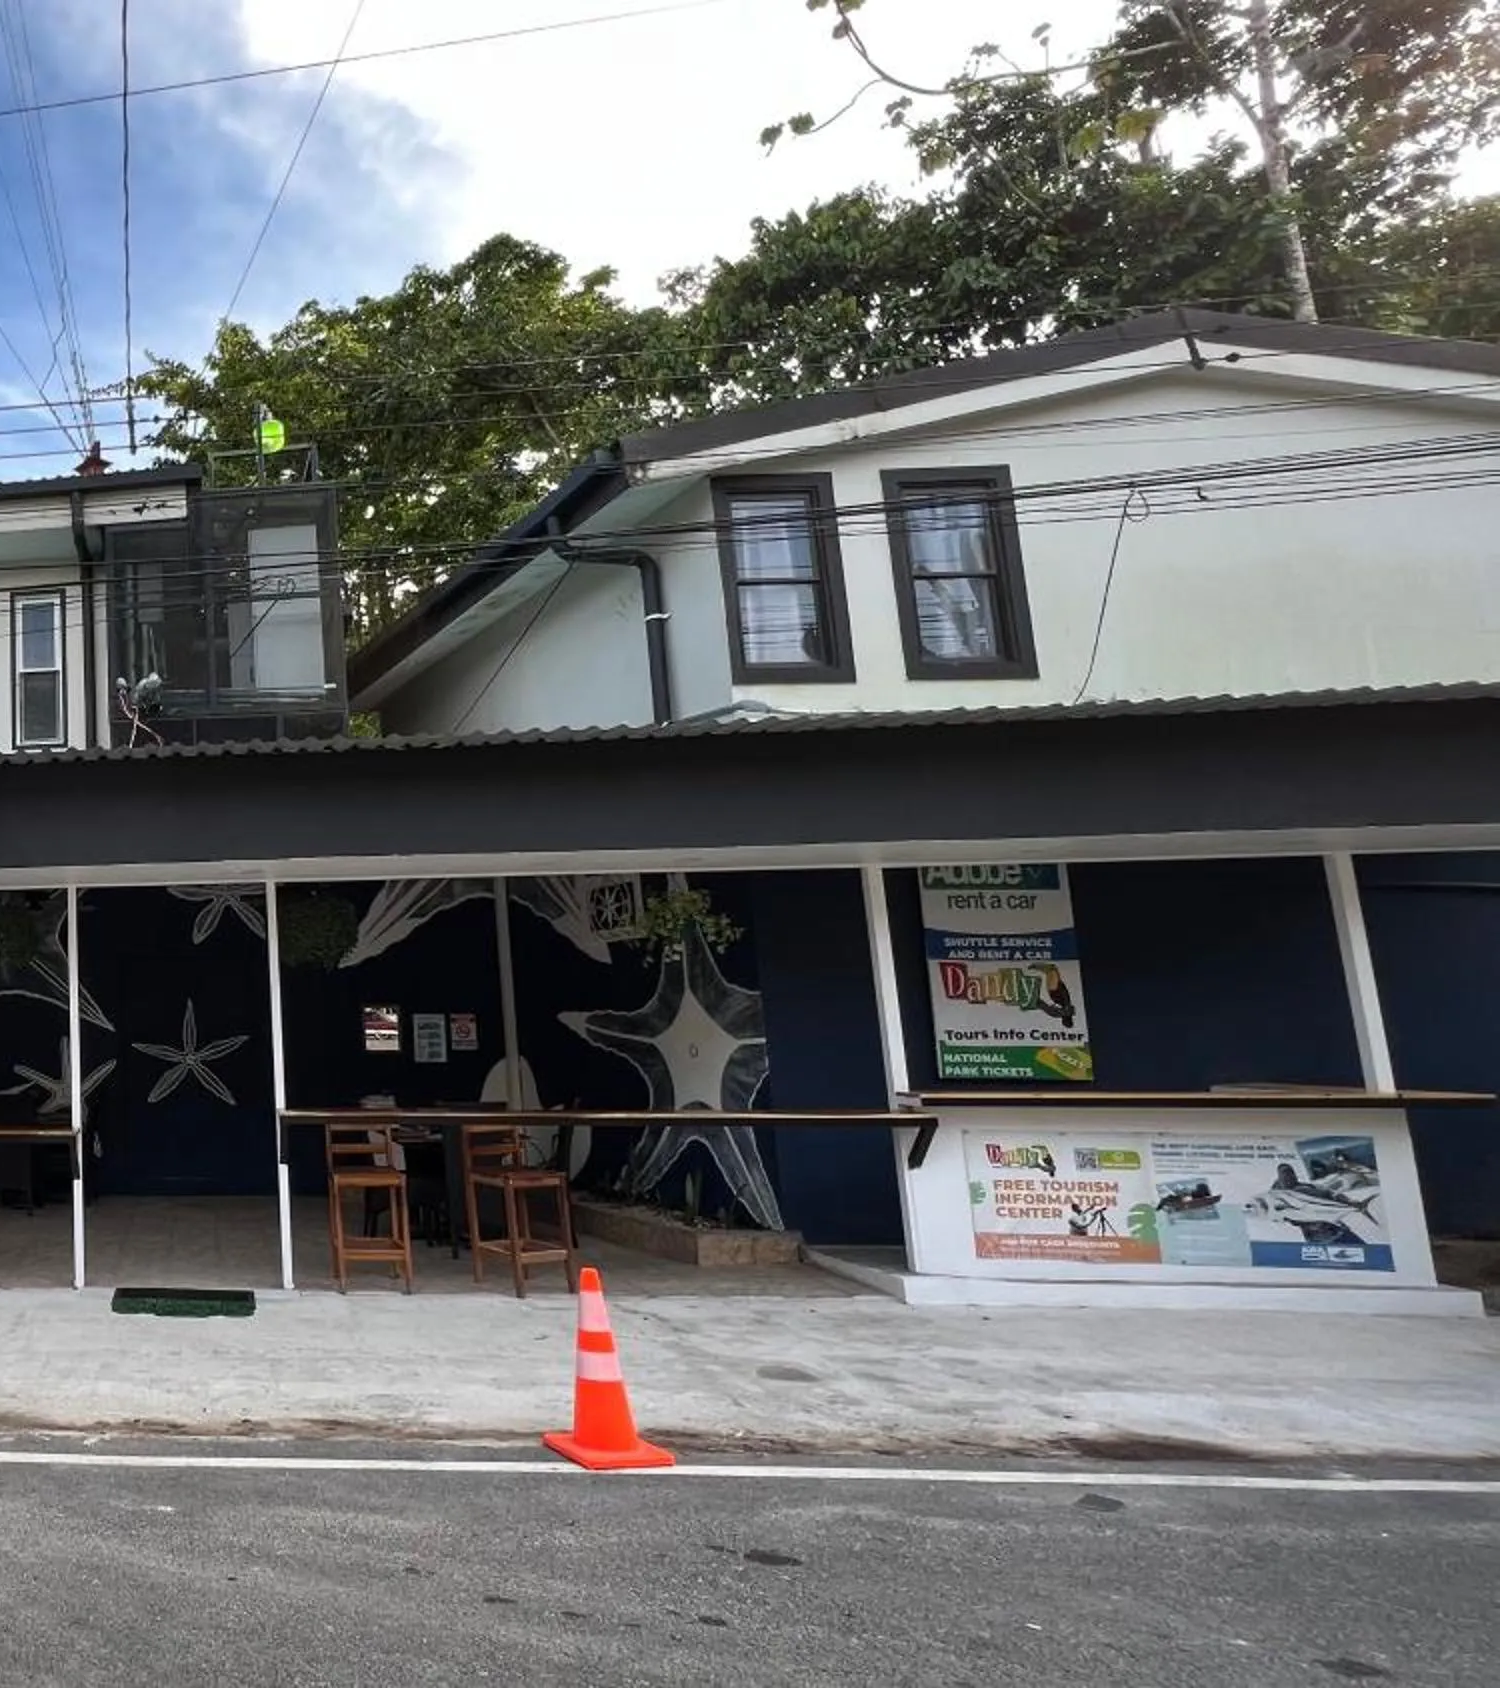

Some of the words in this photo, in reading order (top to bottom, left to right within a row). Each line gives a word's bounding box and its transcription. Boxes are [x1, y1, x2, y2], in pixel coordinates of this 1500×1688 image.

[947, 892, 987, 909] rent
[990, 895, 1001, 909] a
[1007, 895, 1037, 909] car
[944, 937, 999, 947] SHUTTLE
[1001, 937, 1052, 947] SERVICE
[948, 951, 974, 959] AND
[977, 951, 1011, 959] RENT
[1023, 951, 1051, 959] CAR
[941, 963, 1042, 1010] Dandy
[944, 1029, 988, 1040] Tours
[994, 1029, 1025, 1040] Info
[1029, 1029, 1085, 1041] Center
[944, 1053, 1007, 1063] NATIONAL
[945, 1066, 980, 1077] PARK
[982, 1067, 1034, 1077] TICKETS
[994, 1180, 1035, 1191] FREE
[1040, 1180, 1119, 1193] TOURISM
[996, 1193, 1117, 1207] INFORMATION
[996, 1206, 1062, 1219] CENTER
